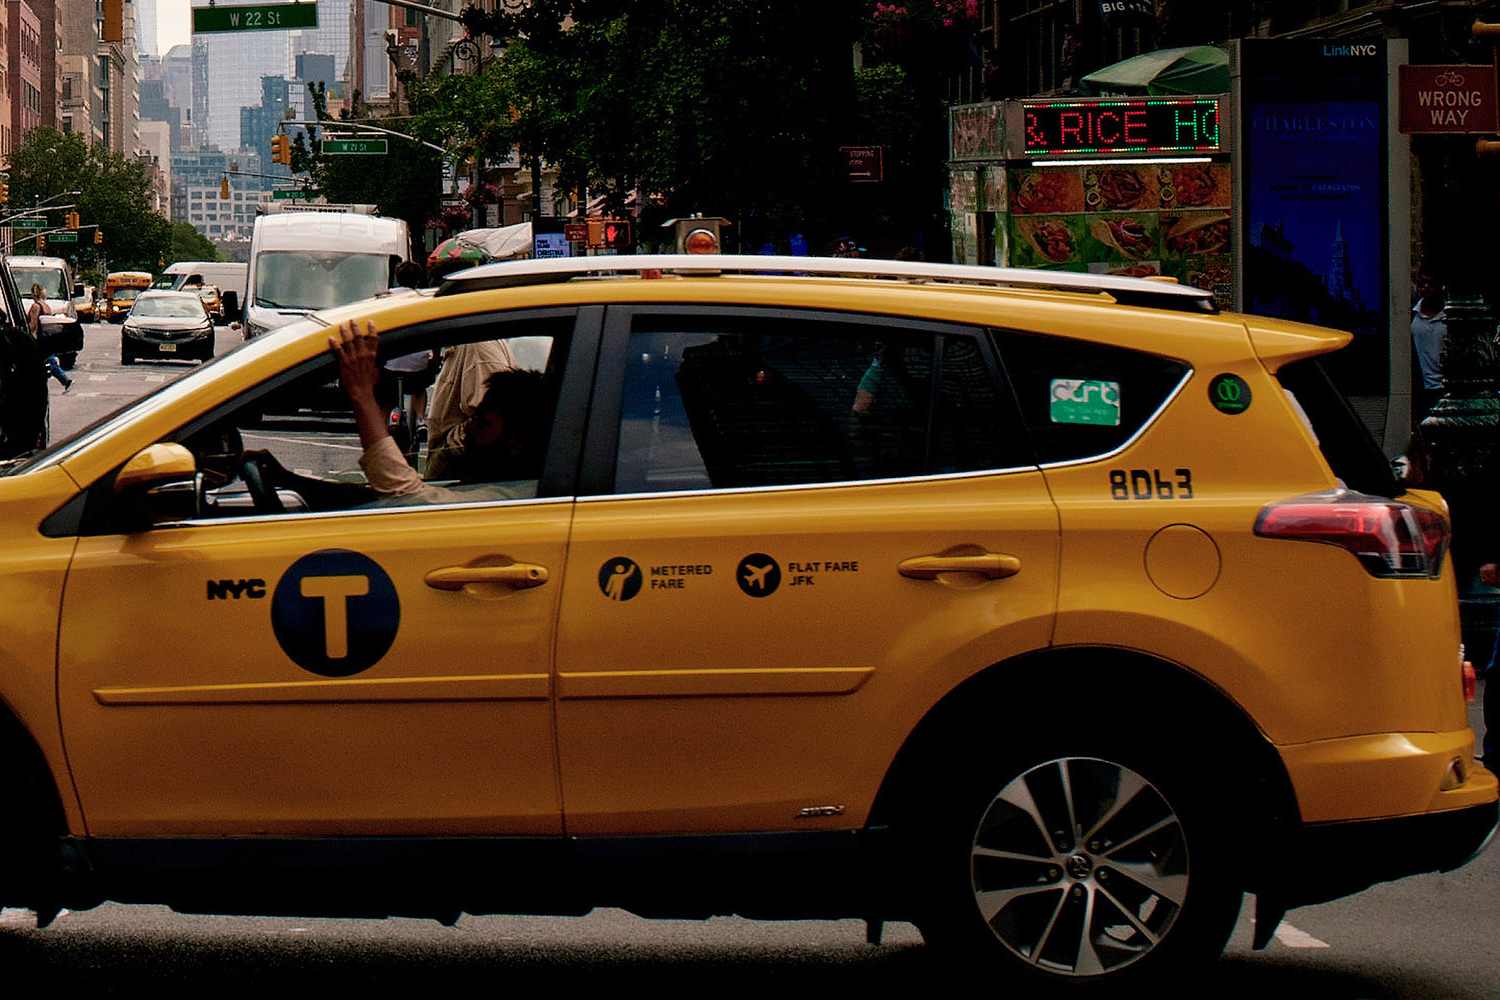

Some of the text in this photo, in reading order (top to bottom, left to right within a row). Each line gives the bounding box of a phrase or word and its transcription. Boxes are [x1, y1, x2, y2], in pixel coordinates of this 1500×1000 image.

[1102, 0, 1125, 13] BIG
[230, 11, 281, 26] W 22 St
[1323, 44, 1377, 57] LinkNYC
[1418, 91, 1482, 107] WRONG
[1430, 109, 1469, 126] WAY
[1060, 110, 1148, 145] RICE
[341, 143, 349, 151] W
[651, 565, 713, 576] METERED
[788, 561, 859, 574] FLAT FARE
[651, 579, 685, 590] FARE
[789, 576, 815, 586] JFK
[206, 578, 267, 600] NYC
[301, 575, 370, 659] T
